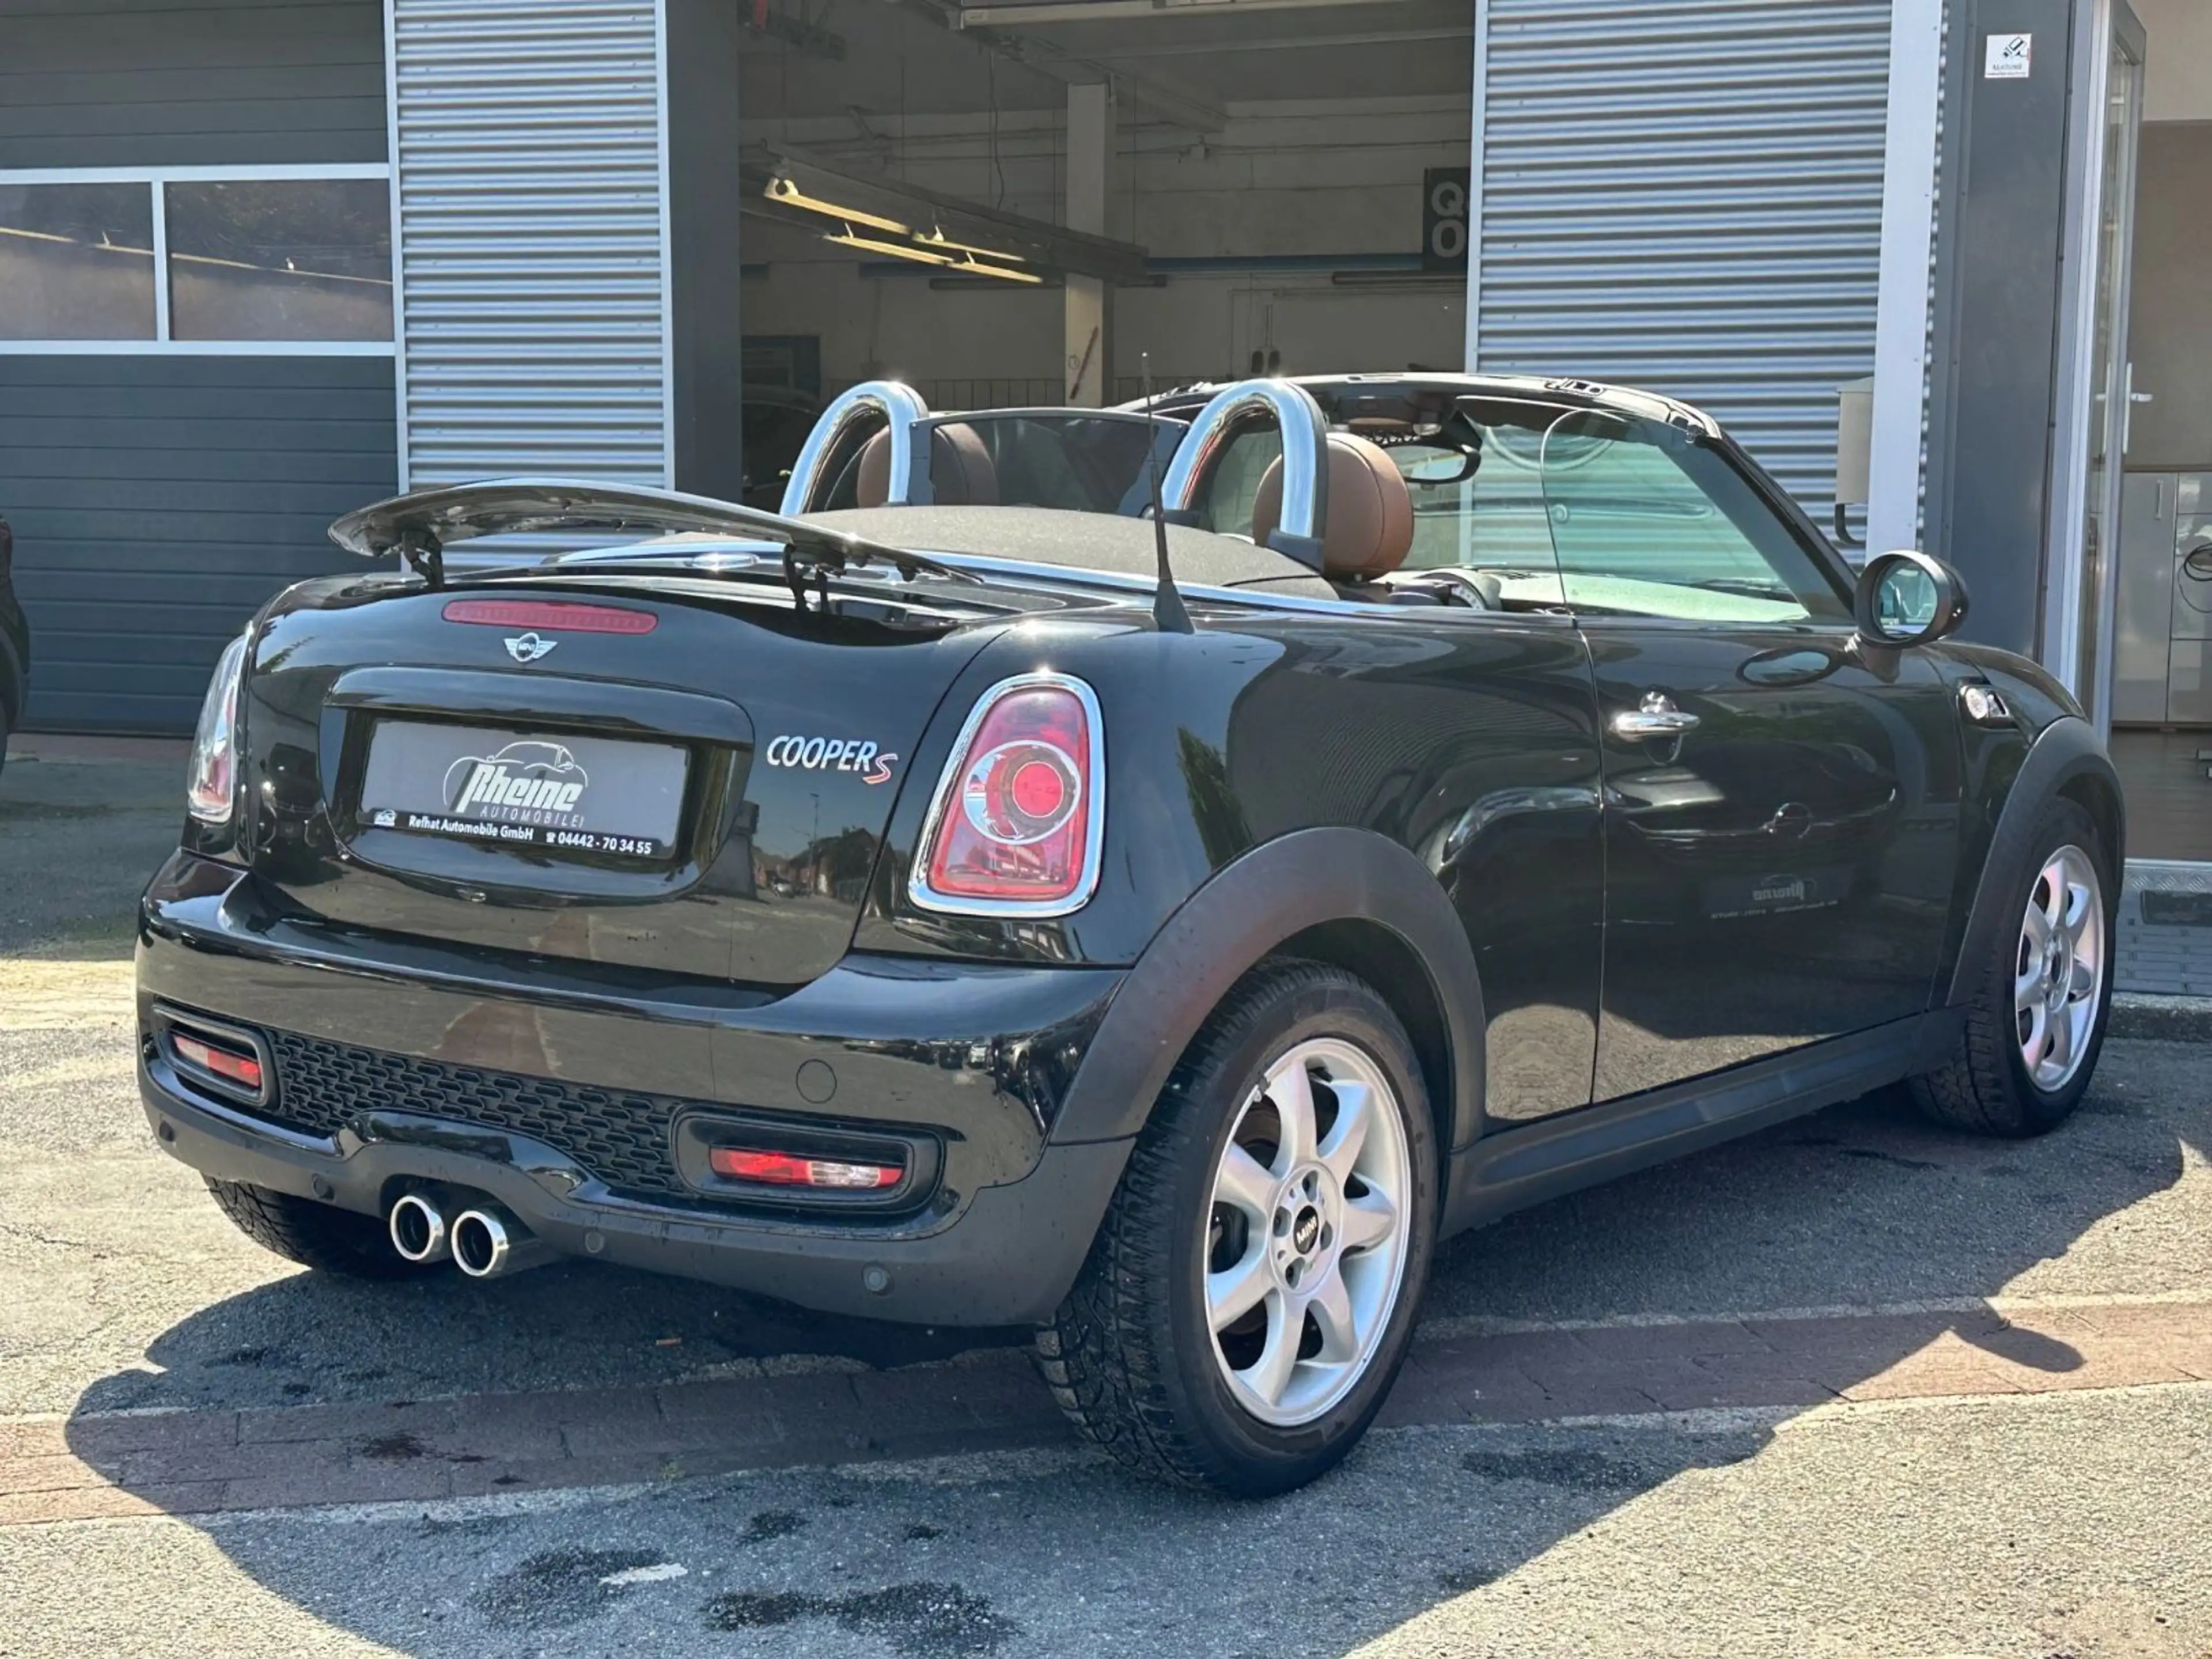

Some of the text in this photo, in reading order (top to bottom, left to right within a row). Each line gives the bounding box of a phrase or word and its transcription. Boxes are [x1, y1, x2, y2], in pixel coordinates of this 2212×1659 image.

[767, 735, 899, 785] COOPER S
[441, 819, 498, 838] Automobile
[500, 825, 534, 841] GmbH
[558, 832, 594, 849] 04442
[603, 837, 618, 851] 70
[619, 839, 634, 852] 34
[636, 842, 653, 855] 55
[1296, 1215, 1317, 1245] MINI
